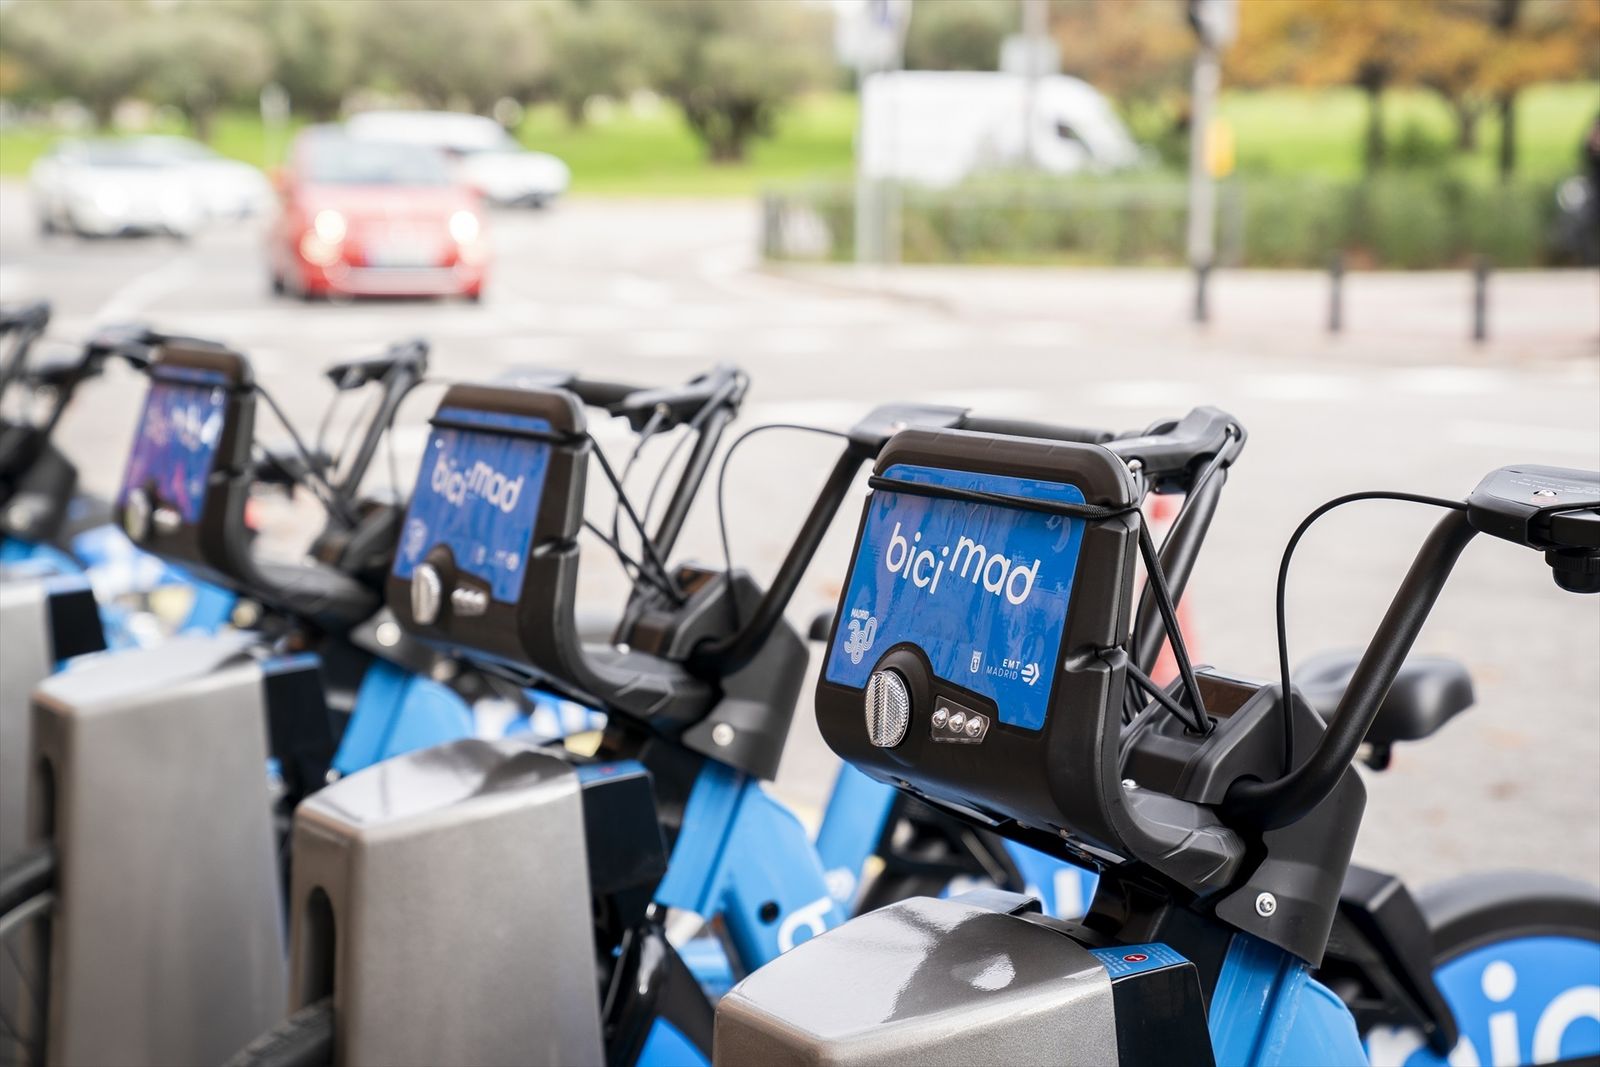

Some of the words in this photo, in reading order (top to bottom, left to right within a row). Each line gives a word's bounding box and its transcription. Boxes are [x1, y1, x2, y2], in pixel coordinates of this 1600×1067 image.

[843, 616, 878, 665] 360
[1002, 658, 1021, 670] EMT
[985, 665, 1018, 680] MADRID
